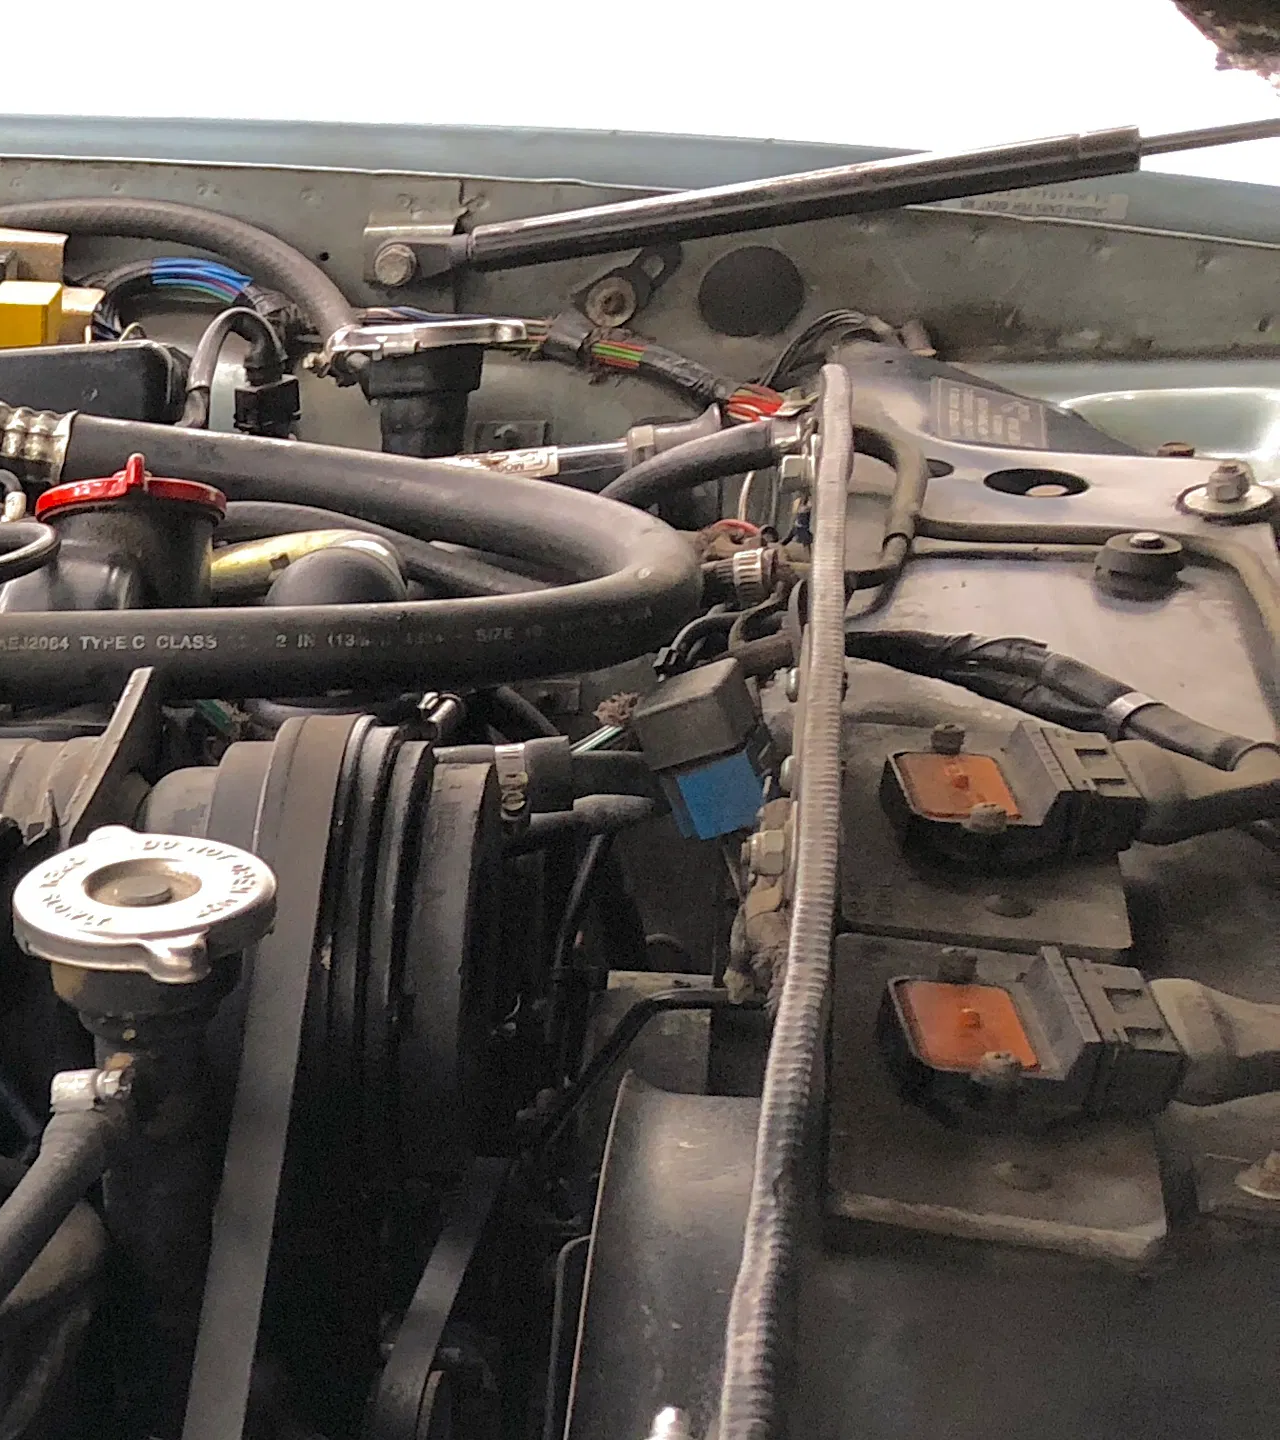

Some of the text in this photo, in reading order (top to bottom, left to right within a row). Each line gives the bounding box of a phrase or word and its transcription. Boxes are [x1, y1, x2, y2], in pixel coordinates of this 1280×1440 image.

[79, 635, 127, 650] TYPE
[131, 635, 146, 650] C
[156, 634, 218, 650] CLASS
